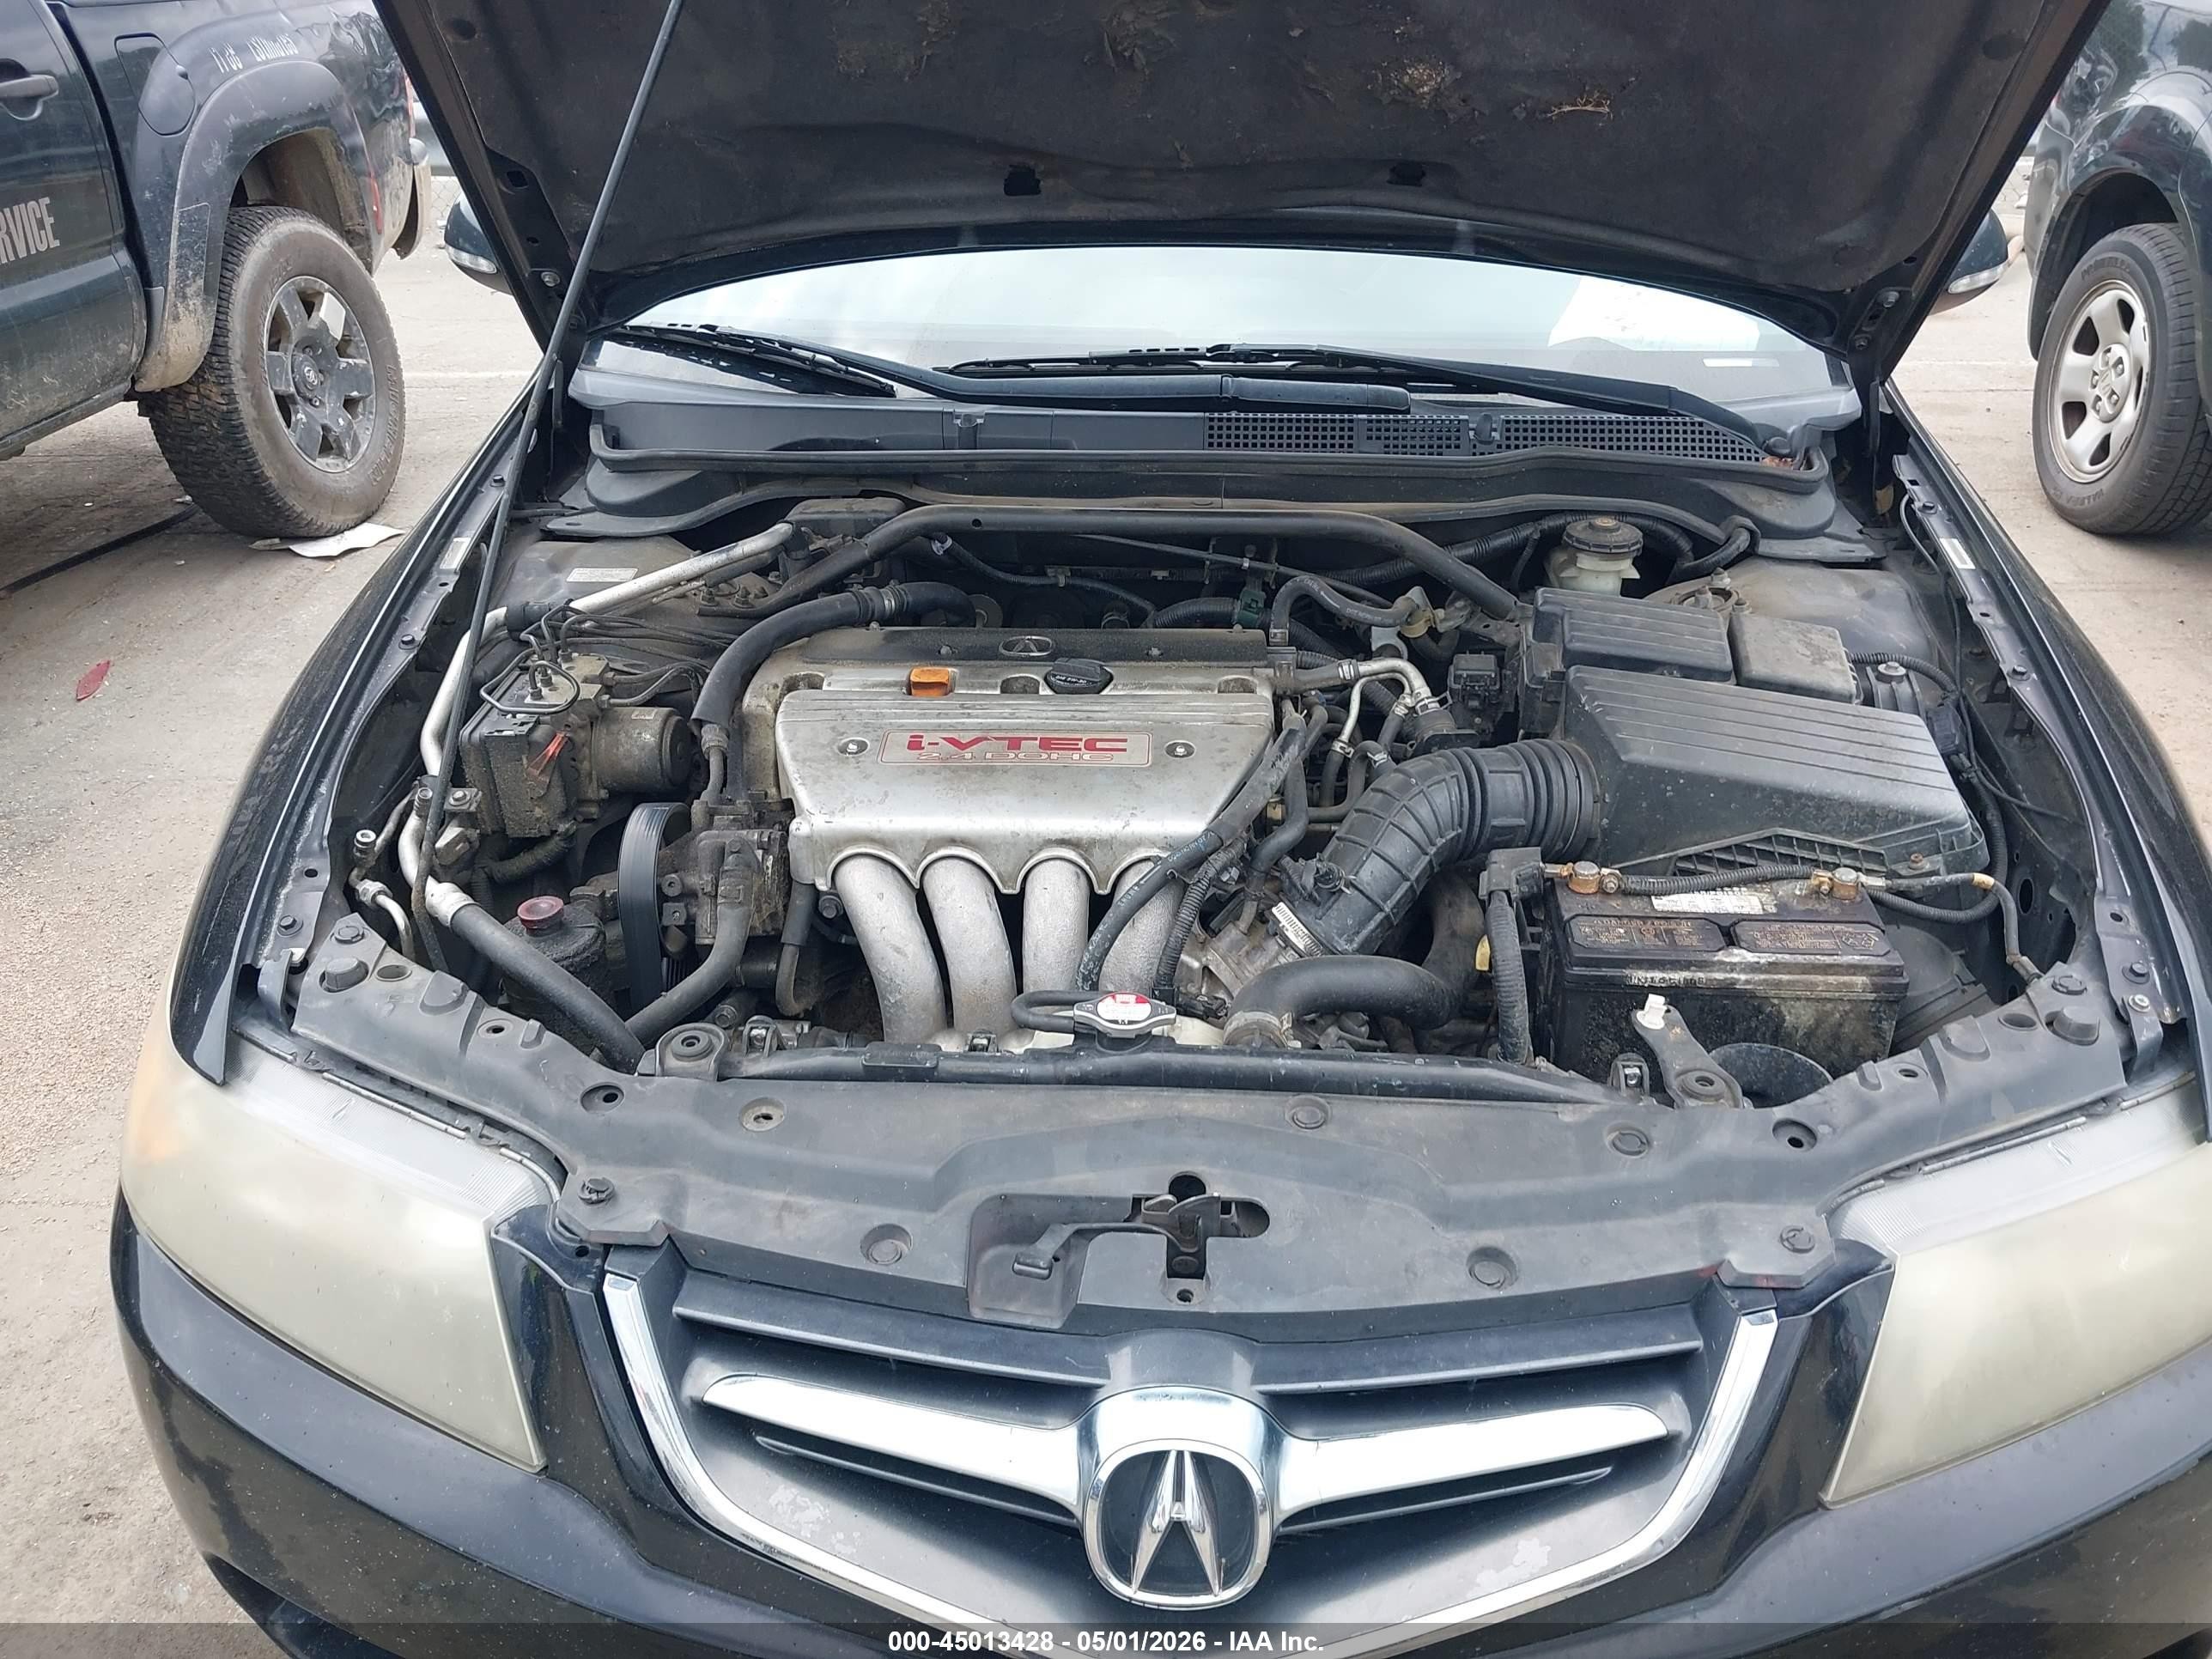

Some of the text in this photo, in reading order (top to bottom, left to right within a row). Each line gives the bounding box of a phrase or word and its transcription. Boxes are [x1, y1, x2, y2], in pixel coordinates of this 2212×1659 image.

[0, 197, 60, 265] RVICE
[907, 734, 1128, 752] i-VTEC
[916, 752, 1115, 763] 2.4 DOHC
